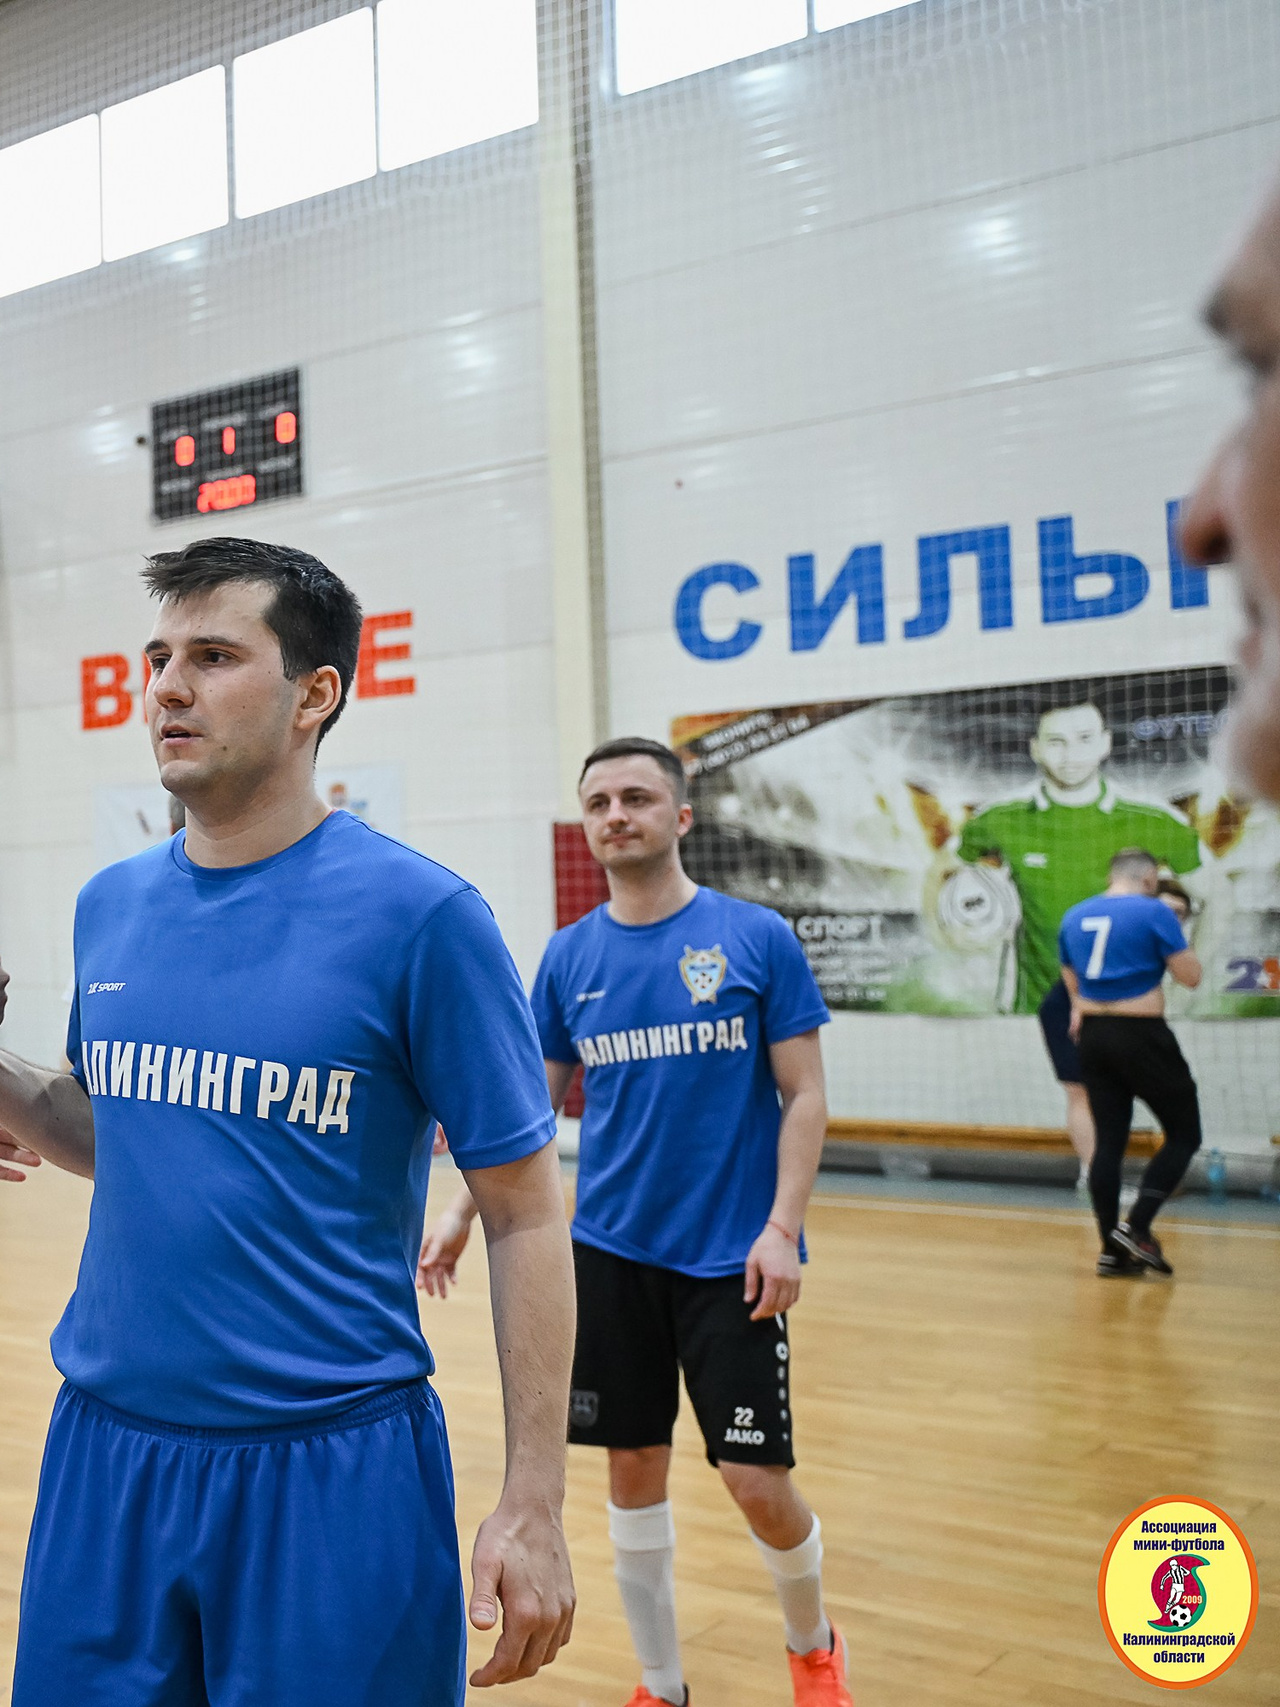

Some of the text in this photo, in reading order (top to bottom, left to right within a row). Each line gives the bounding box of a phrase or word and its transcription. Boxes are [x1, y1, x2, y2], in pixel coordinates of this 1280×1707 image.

[81, 609, 416, 731] ВЕ
[1080, 914, 1112, 980] 7
[724, 1427, 765, 1446] JAKO
[733, 1406, 755, 1427] 22
